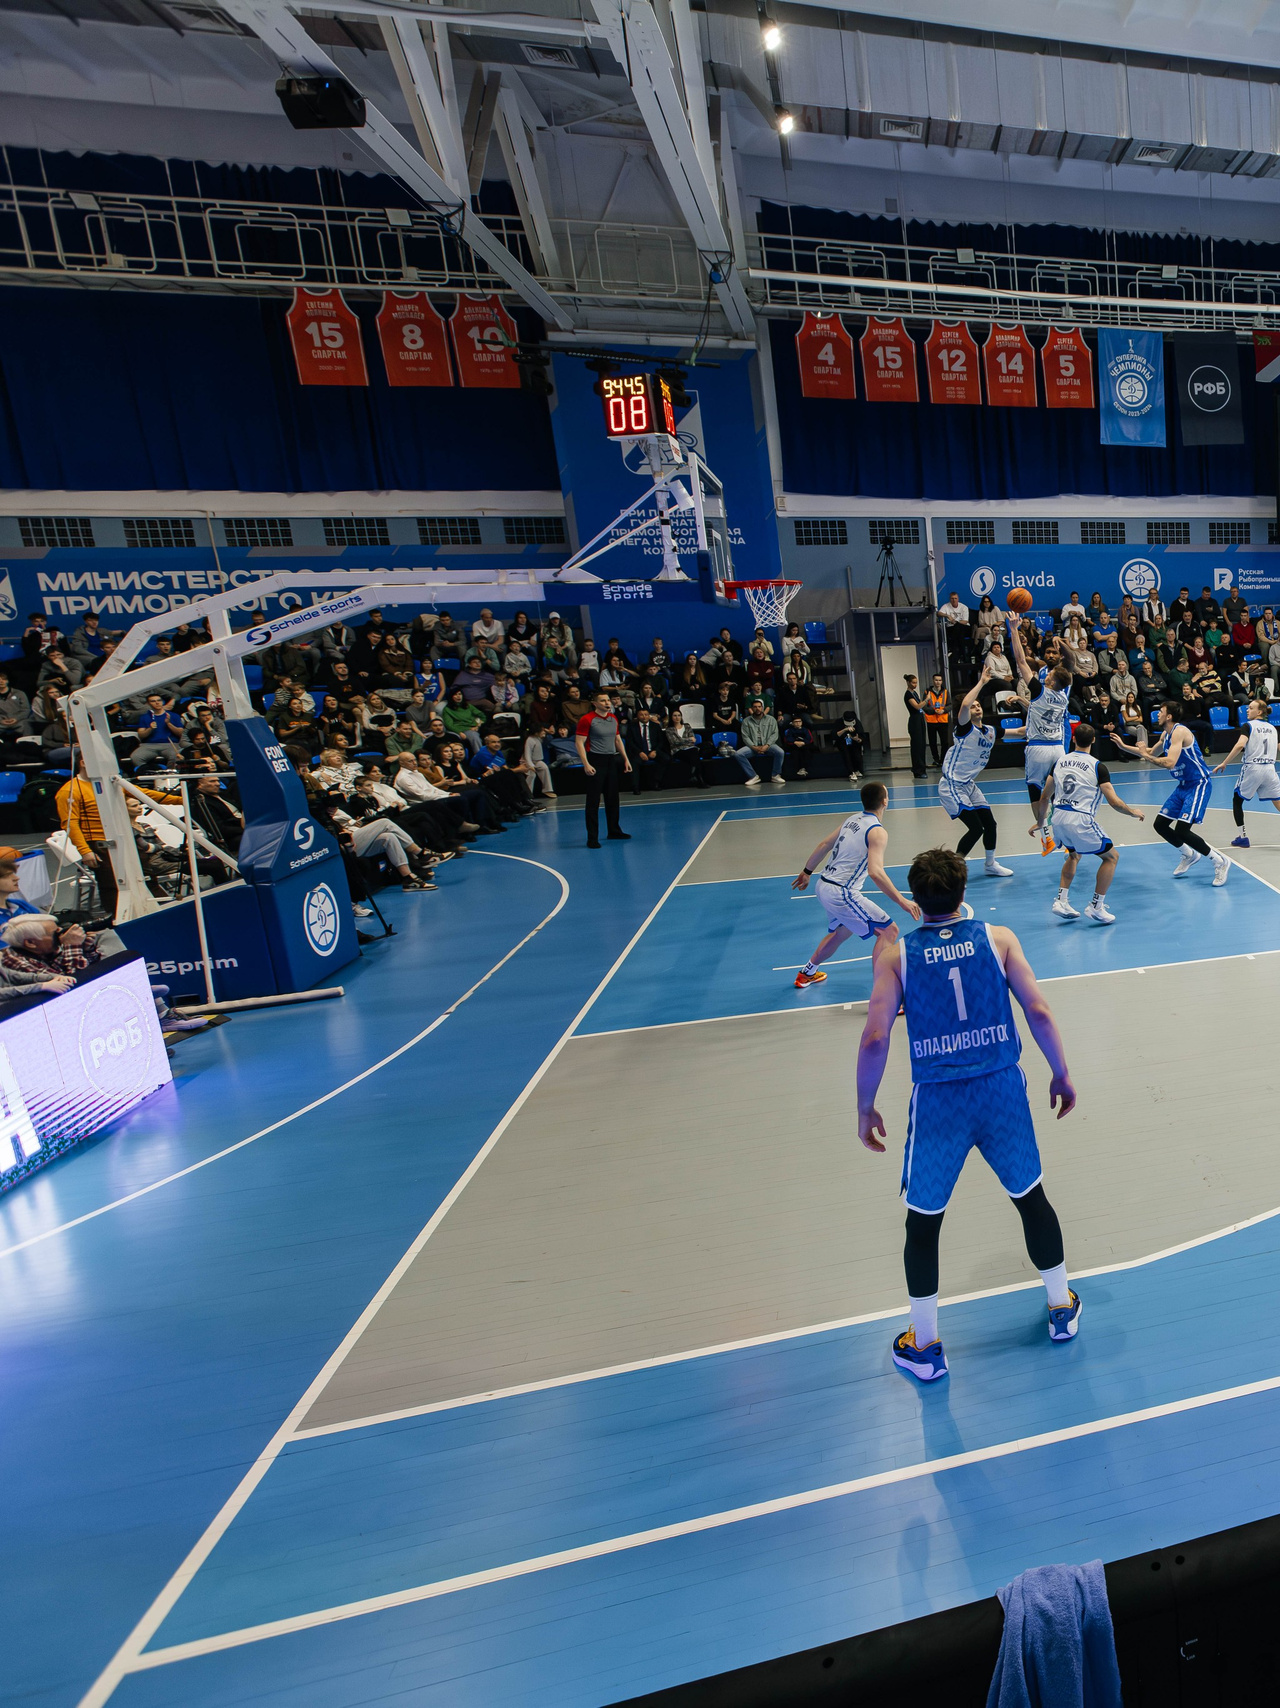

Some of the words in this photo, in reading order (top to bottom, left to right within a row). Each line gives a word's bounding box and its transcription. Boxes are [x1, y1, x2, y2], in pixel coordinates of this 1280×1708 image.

[305, 322, 344, 348] 15
[402, 324, 425, 350] 8
[467, 326, 505, 352] 10
[312, 350, 348, 359] СПАРТАК
[400, 351, 433, 361] СПАРТАК
[473, 353, 506, 362] СПАРТАК
[817, 343, 836, 365] 4
[873, 346, 903, 369] 15
[938, 349, 967, 372] 12
[996, 352, 1025, 375] 14
[1115, 354, 1147, 365] СУПЕРЛИГА
[813, 366, 842, 376] СПАРТАК
[877, 370, 904, 379] СПАРТАК
[1059, 355, 1076, 377] 5
[1110, 361, 1154, 381] ЧЕМПИОНЫ
[941, 373, 968, 382] СПАРТАК
[998, 375, 1024, 384] СПАРТАК
[1056, 378, 1081, 386] СПАРТАК
[1193, 382, 1226, 395] РФБ
[609, 395, 647, 432] 08
[1002, 569, 1056, 588] slavda
[1238, 568, 1264, 576] Русская
[602, 584, 653, 593] Schelde
[603, 591, 654, 601] Sports
[269, 609, 321, 633] Schelde
[320, 594, 363, 614] Sports
[263, 744, 285, 760] FON
[1262, 738, 1269, 755] 1
[271, 758, 291, 773] BET
[1059, 760, 1090, 772] ХАКУНОВ
[1062, 773, 1077, 795] 6
[289, 852, 311, 870] Schelde
[311, 847, 330, 863] Sports
[923, 941, 975, 965] ЕРШОВ
[947, 966, 968, 1022] 1
[90, 1016, 143, 1069] РФБ
[913, 1023, 1010, 1059] ВЛАДИВОСТОК
